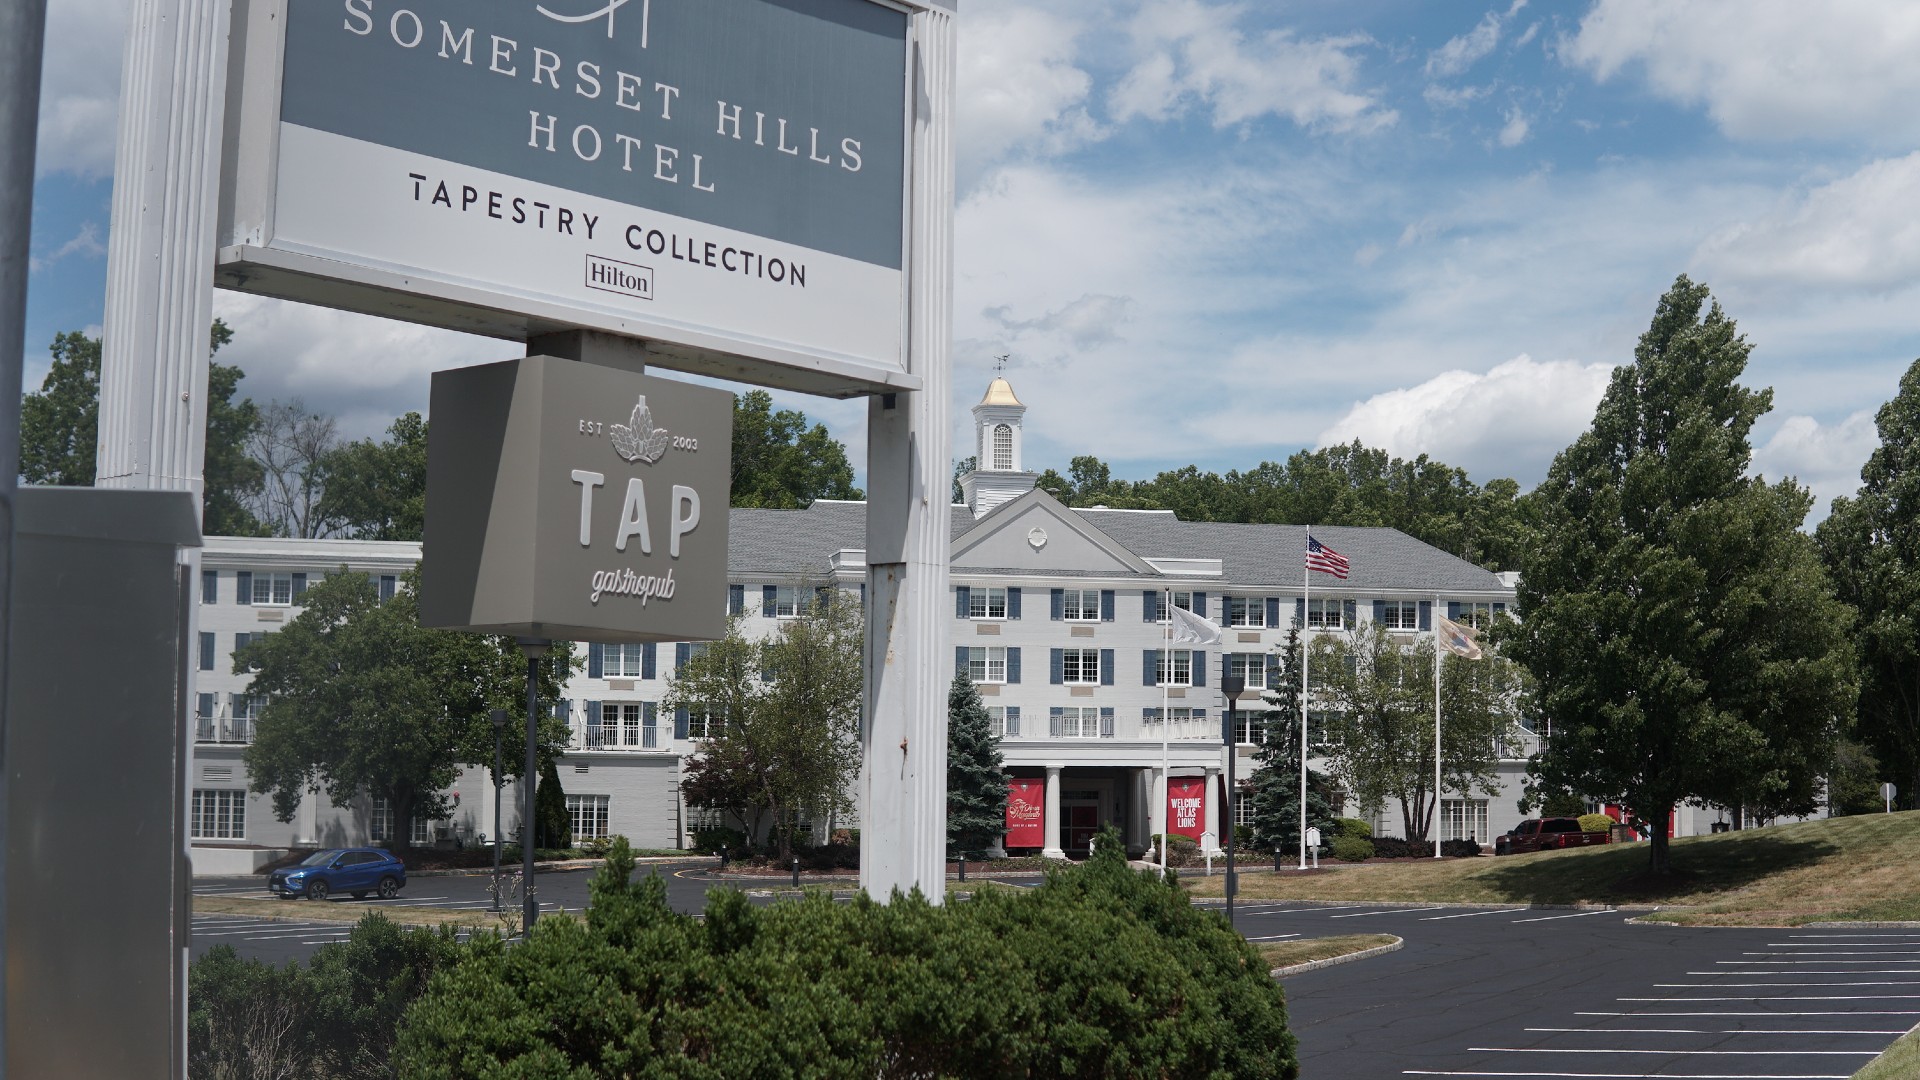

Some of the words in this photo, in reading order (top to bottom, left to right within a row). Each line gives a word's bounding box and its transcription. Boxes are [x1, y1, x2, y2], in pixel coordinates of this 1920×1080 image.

[344, 0, 680, 120] SOMERSET
[716, 100, 862, 172] HILLS
[528, 110, 715, 193] HOTEL
[408, 172, 599, 240] TAPESTRY
[625, 224, 805, 288] COLLECTION
[591, 262, 648, 293] Hilton
[579, 419, 603, 435] EST
[673, 435, 698, 450] 2003
[571, 469, 701, 557] TAP
[590, 567, 676, 606] gastropub
[1171, 798, 1201, 809] WELCOME
[1177, 808, 1196, 818] ATLAS
[1178, 817, 1196, 828] LIONS
